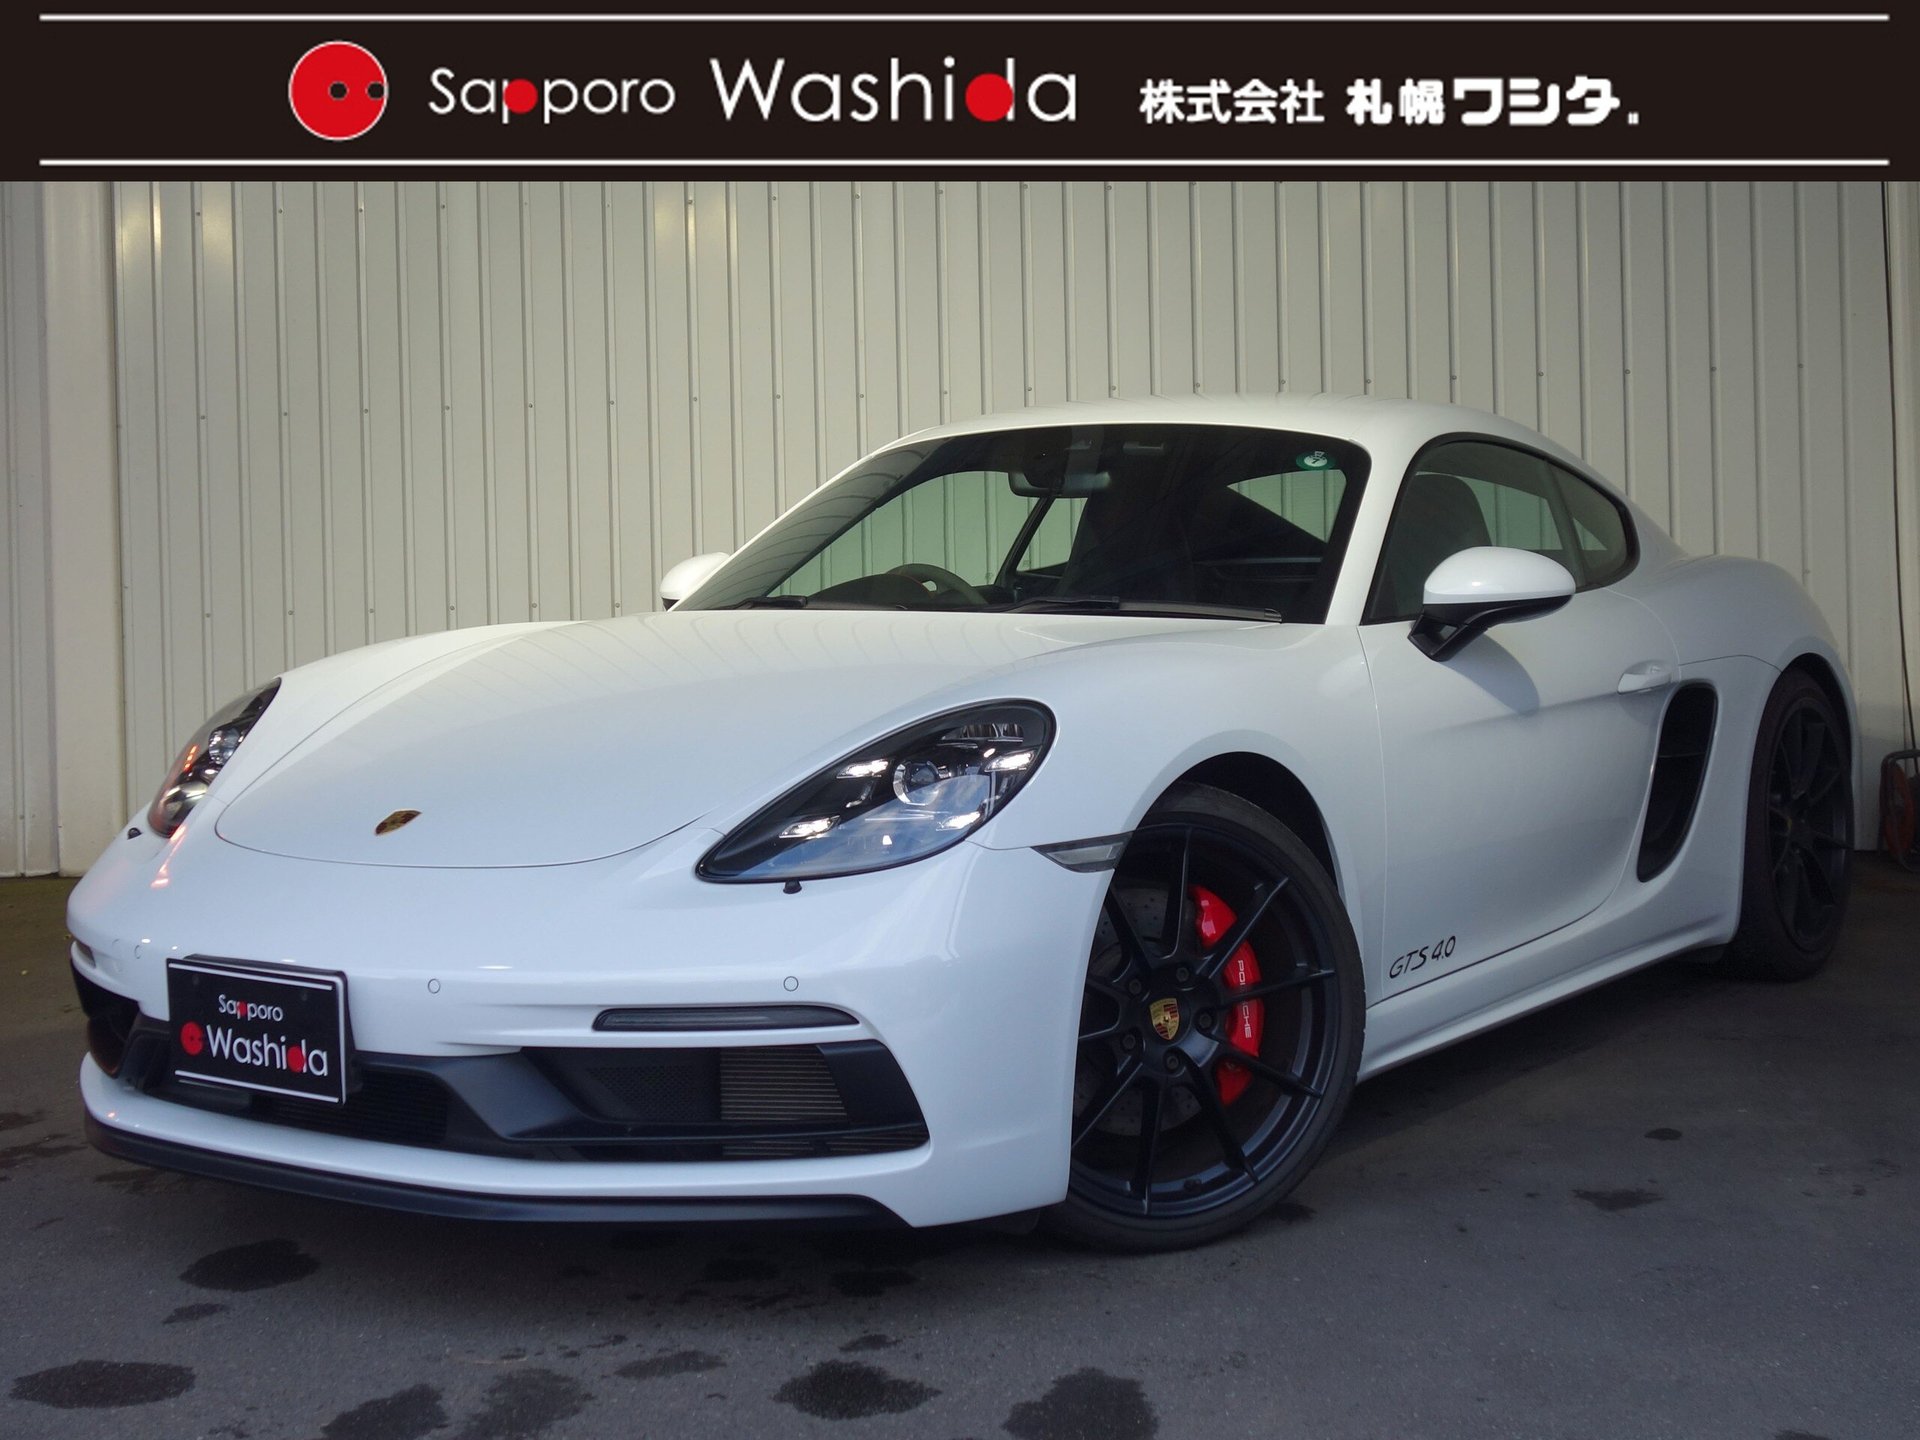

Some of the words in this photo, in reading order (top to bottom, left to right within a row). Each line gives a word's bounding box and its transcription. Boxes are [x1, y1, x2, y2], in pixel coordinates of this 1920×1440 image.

[1388, 945, 1430, 979] GTS
[1431, 935, 1457, 961] 4.0
[218, 993, 284, 1022] Sapporo
[1237, 959, 1252, 1039] POCHE
[206, 1023, 328, 1077] Washida
